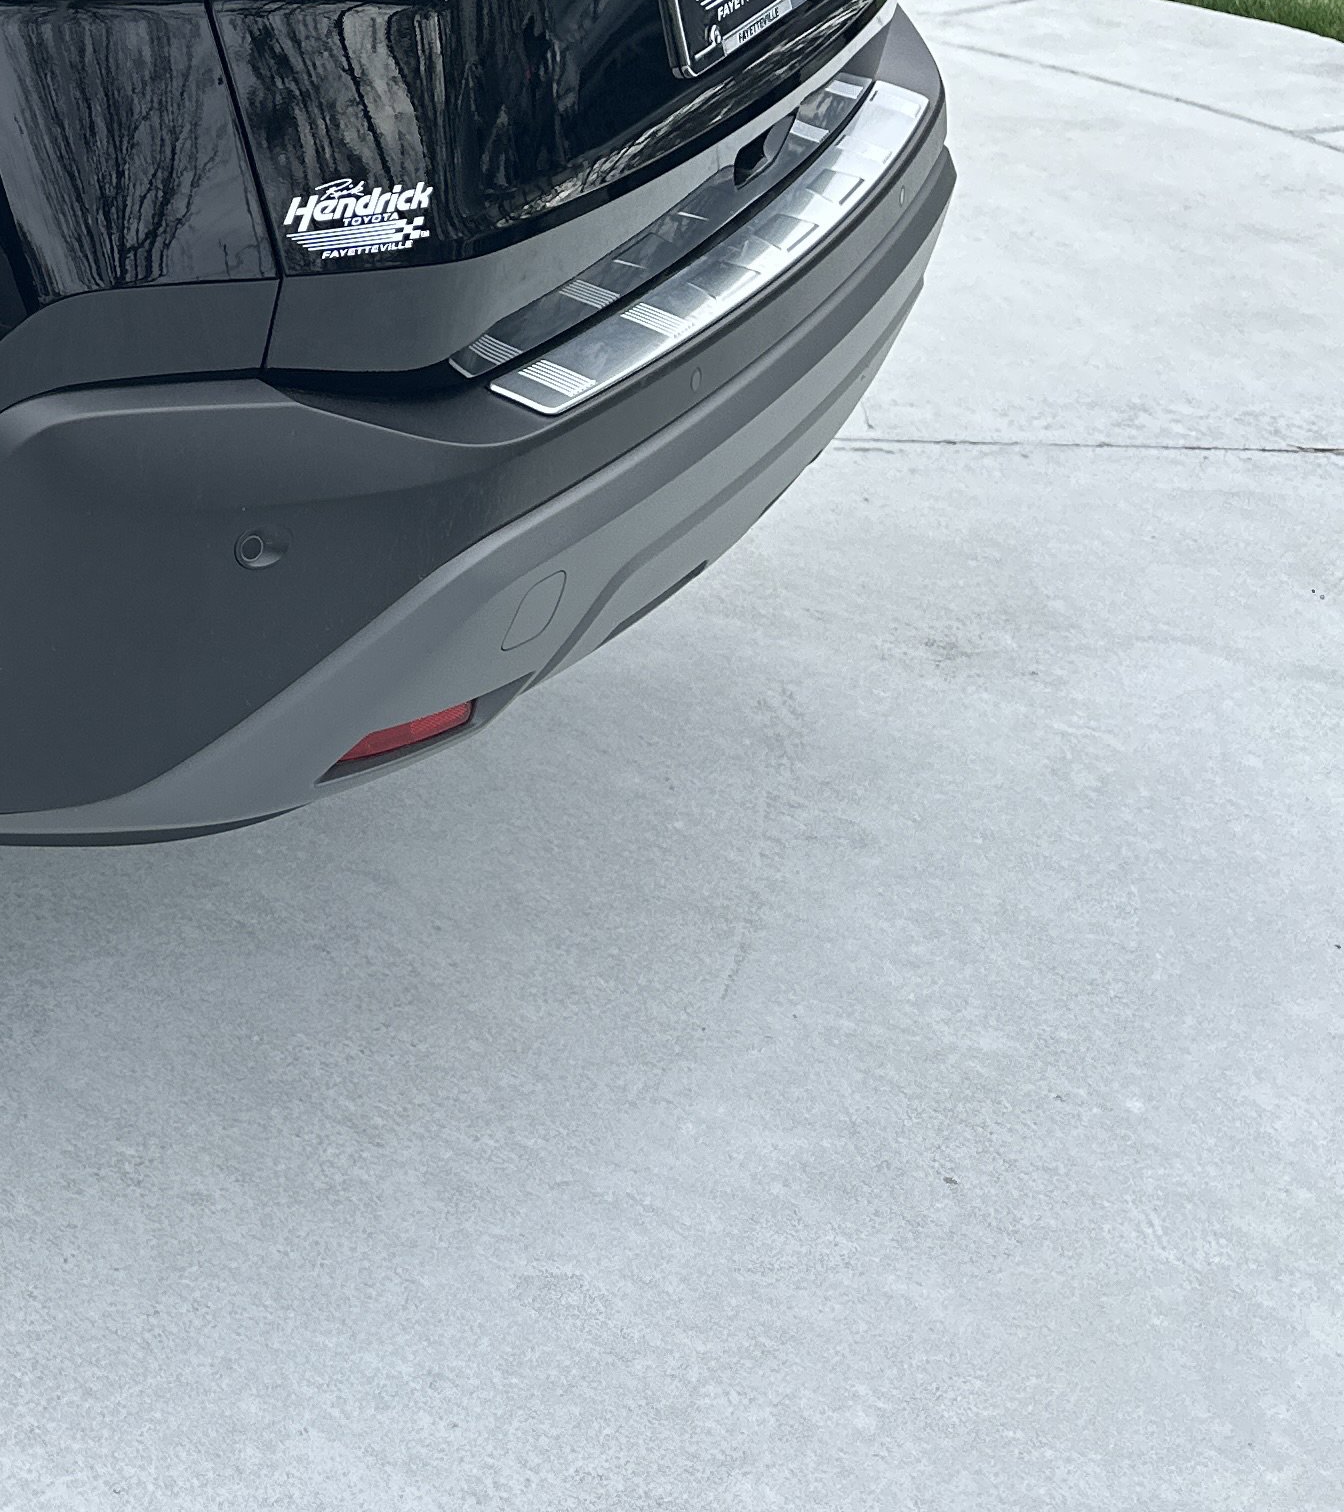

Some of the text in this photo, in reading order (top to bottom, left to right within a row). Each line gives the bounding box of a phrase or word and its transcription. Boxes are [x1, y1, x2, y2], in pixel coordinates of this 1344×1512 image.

[738, 7, 779, 44] FAYETTEVILLE
[283, 181, 433, 232] Hendrick
[343, 212, 399, 227] TOYOTA
[321, 240, 413, 260] FAYETTEVILLE
